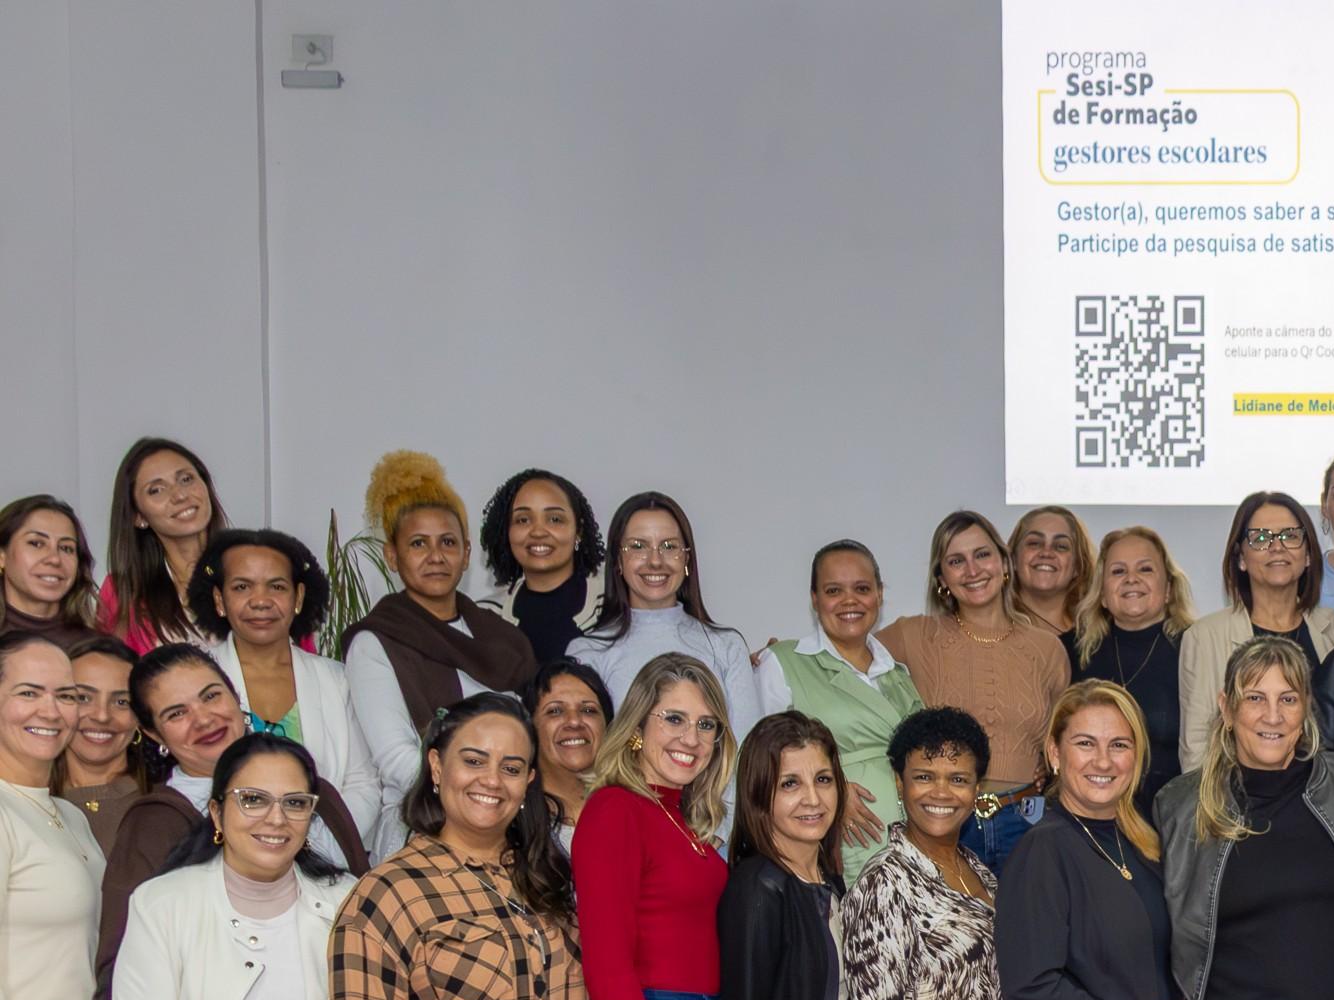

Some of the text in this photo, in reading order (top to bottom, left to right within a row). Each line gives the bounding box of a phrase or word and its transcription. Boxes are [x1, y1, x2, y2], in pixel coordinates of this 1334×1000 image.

[1046, 51, 1147, 76] programa
[1066, 73, 1154, 97] Sesi-SP
[1052, 100, 1198, 132] de Formação
[1053, 137, 1268, 172] gestores escolares
[1057, 201, 1149, 225] Gestor(a),
[1155, 206, 1247, 225] queremos
[1253, 201, 1305, 221] saber
[1310, 206, 1321, 221] a
[1057, 233, 1139, 257] Participe
[1145, 233, 1167, 253] da
[1173, 233, 1257, 257] pesquisa
[1263, 233, 1285, 253] de
[1224, 325, 1263, 339] Aponte
[1265, 327, 1273, 338] a
[1275, 325, 1316, 338] câmera
[1318, 325, 1333, 338] do
[1224, 346, 1262, 358] celular
[1264, 348, 1289, 360] para
[1291, 348, 1298, 358] o
[1233, 399, 1284, 412] Lidiane
[1287, 399, 1304, 412] de
